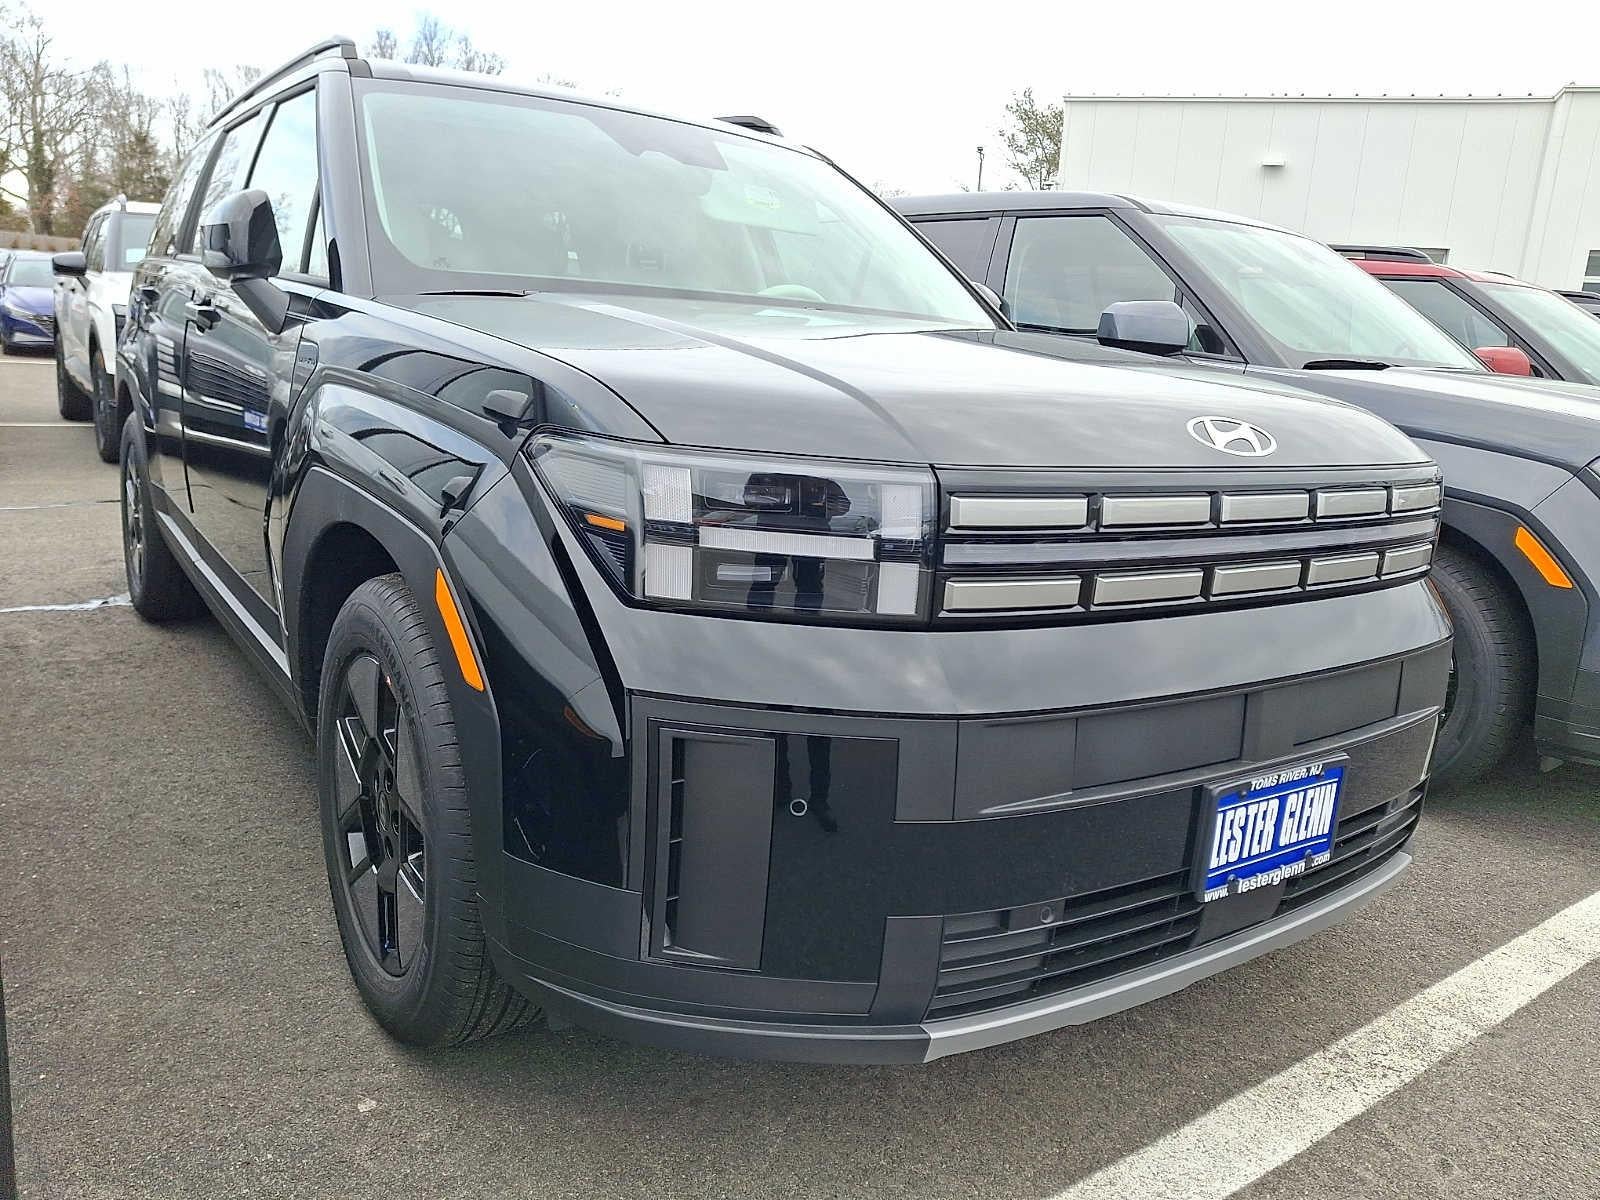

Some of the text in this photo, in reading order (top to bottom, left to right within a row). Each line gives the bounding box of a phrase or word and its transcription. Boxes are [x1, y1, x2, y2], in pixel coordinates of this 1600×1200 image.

[1251, 774, 1279, 791] TOMS
[1309, 764, 1323, 777] NJ
[1209, 783, 1337, 869] LESTER GLENN
[1238, 864, 1305, 893] lesterglenn
